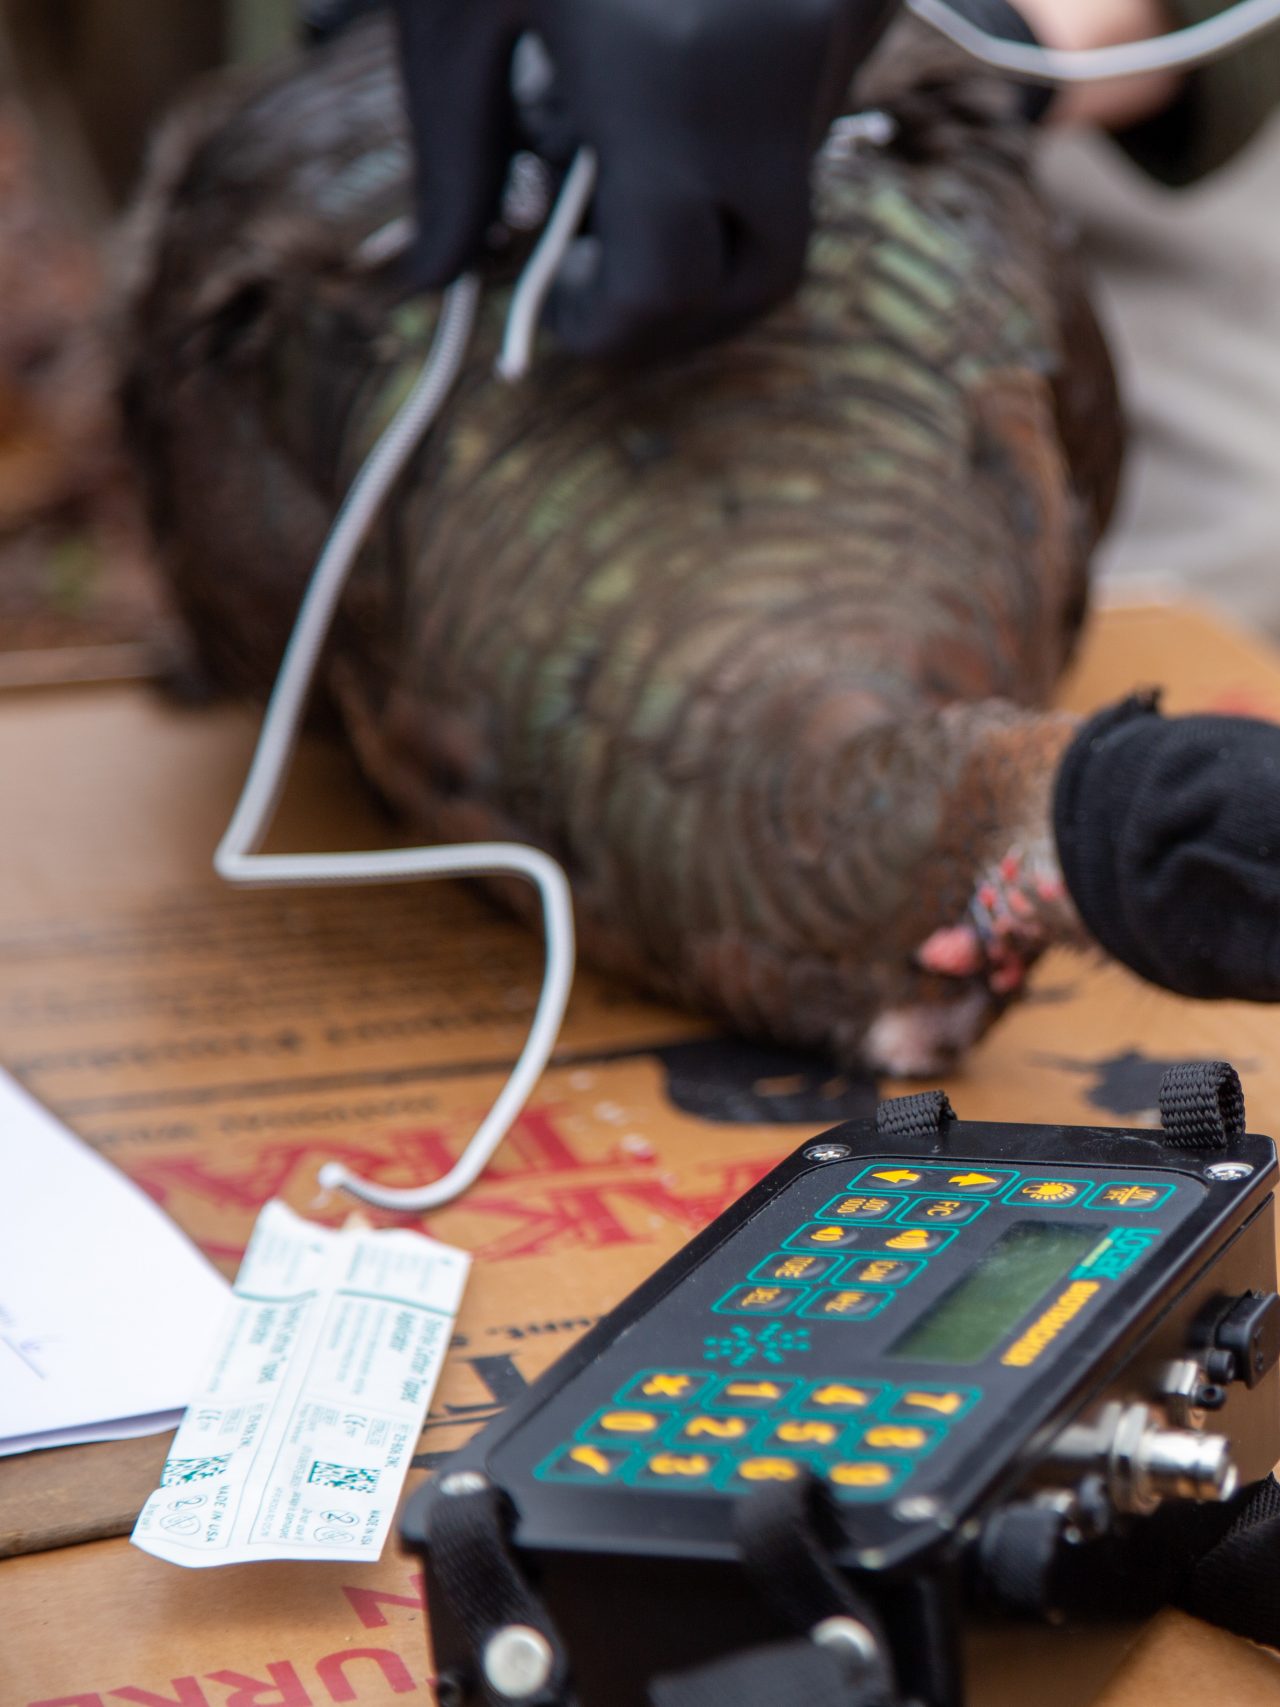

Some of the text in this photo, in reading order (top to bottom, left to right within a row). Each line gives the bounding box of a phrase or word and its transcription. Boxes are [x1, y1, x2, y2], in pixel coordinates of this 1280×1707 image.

[928, 1201, 960, 1216] F/C
[1126, 1187, 1156, 1201] ON
[1086, 1226, 1162, 1281] LOTEK
[1001, 1281, 1100, 1366] BIOTRACKER
[602, 1412, 656, 1431] 0
[651, 1382, 778, 1474] 1 2 3
[741, 1385, 864, 1481] 4 5 6
[831, 1393, 959, 1485] 7 8 9
[206, 1485, 231, 1543] MADE IN USA
[360, 1535, 374, 1546] USA
[365, 1509, 382, 1527] MADE
